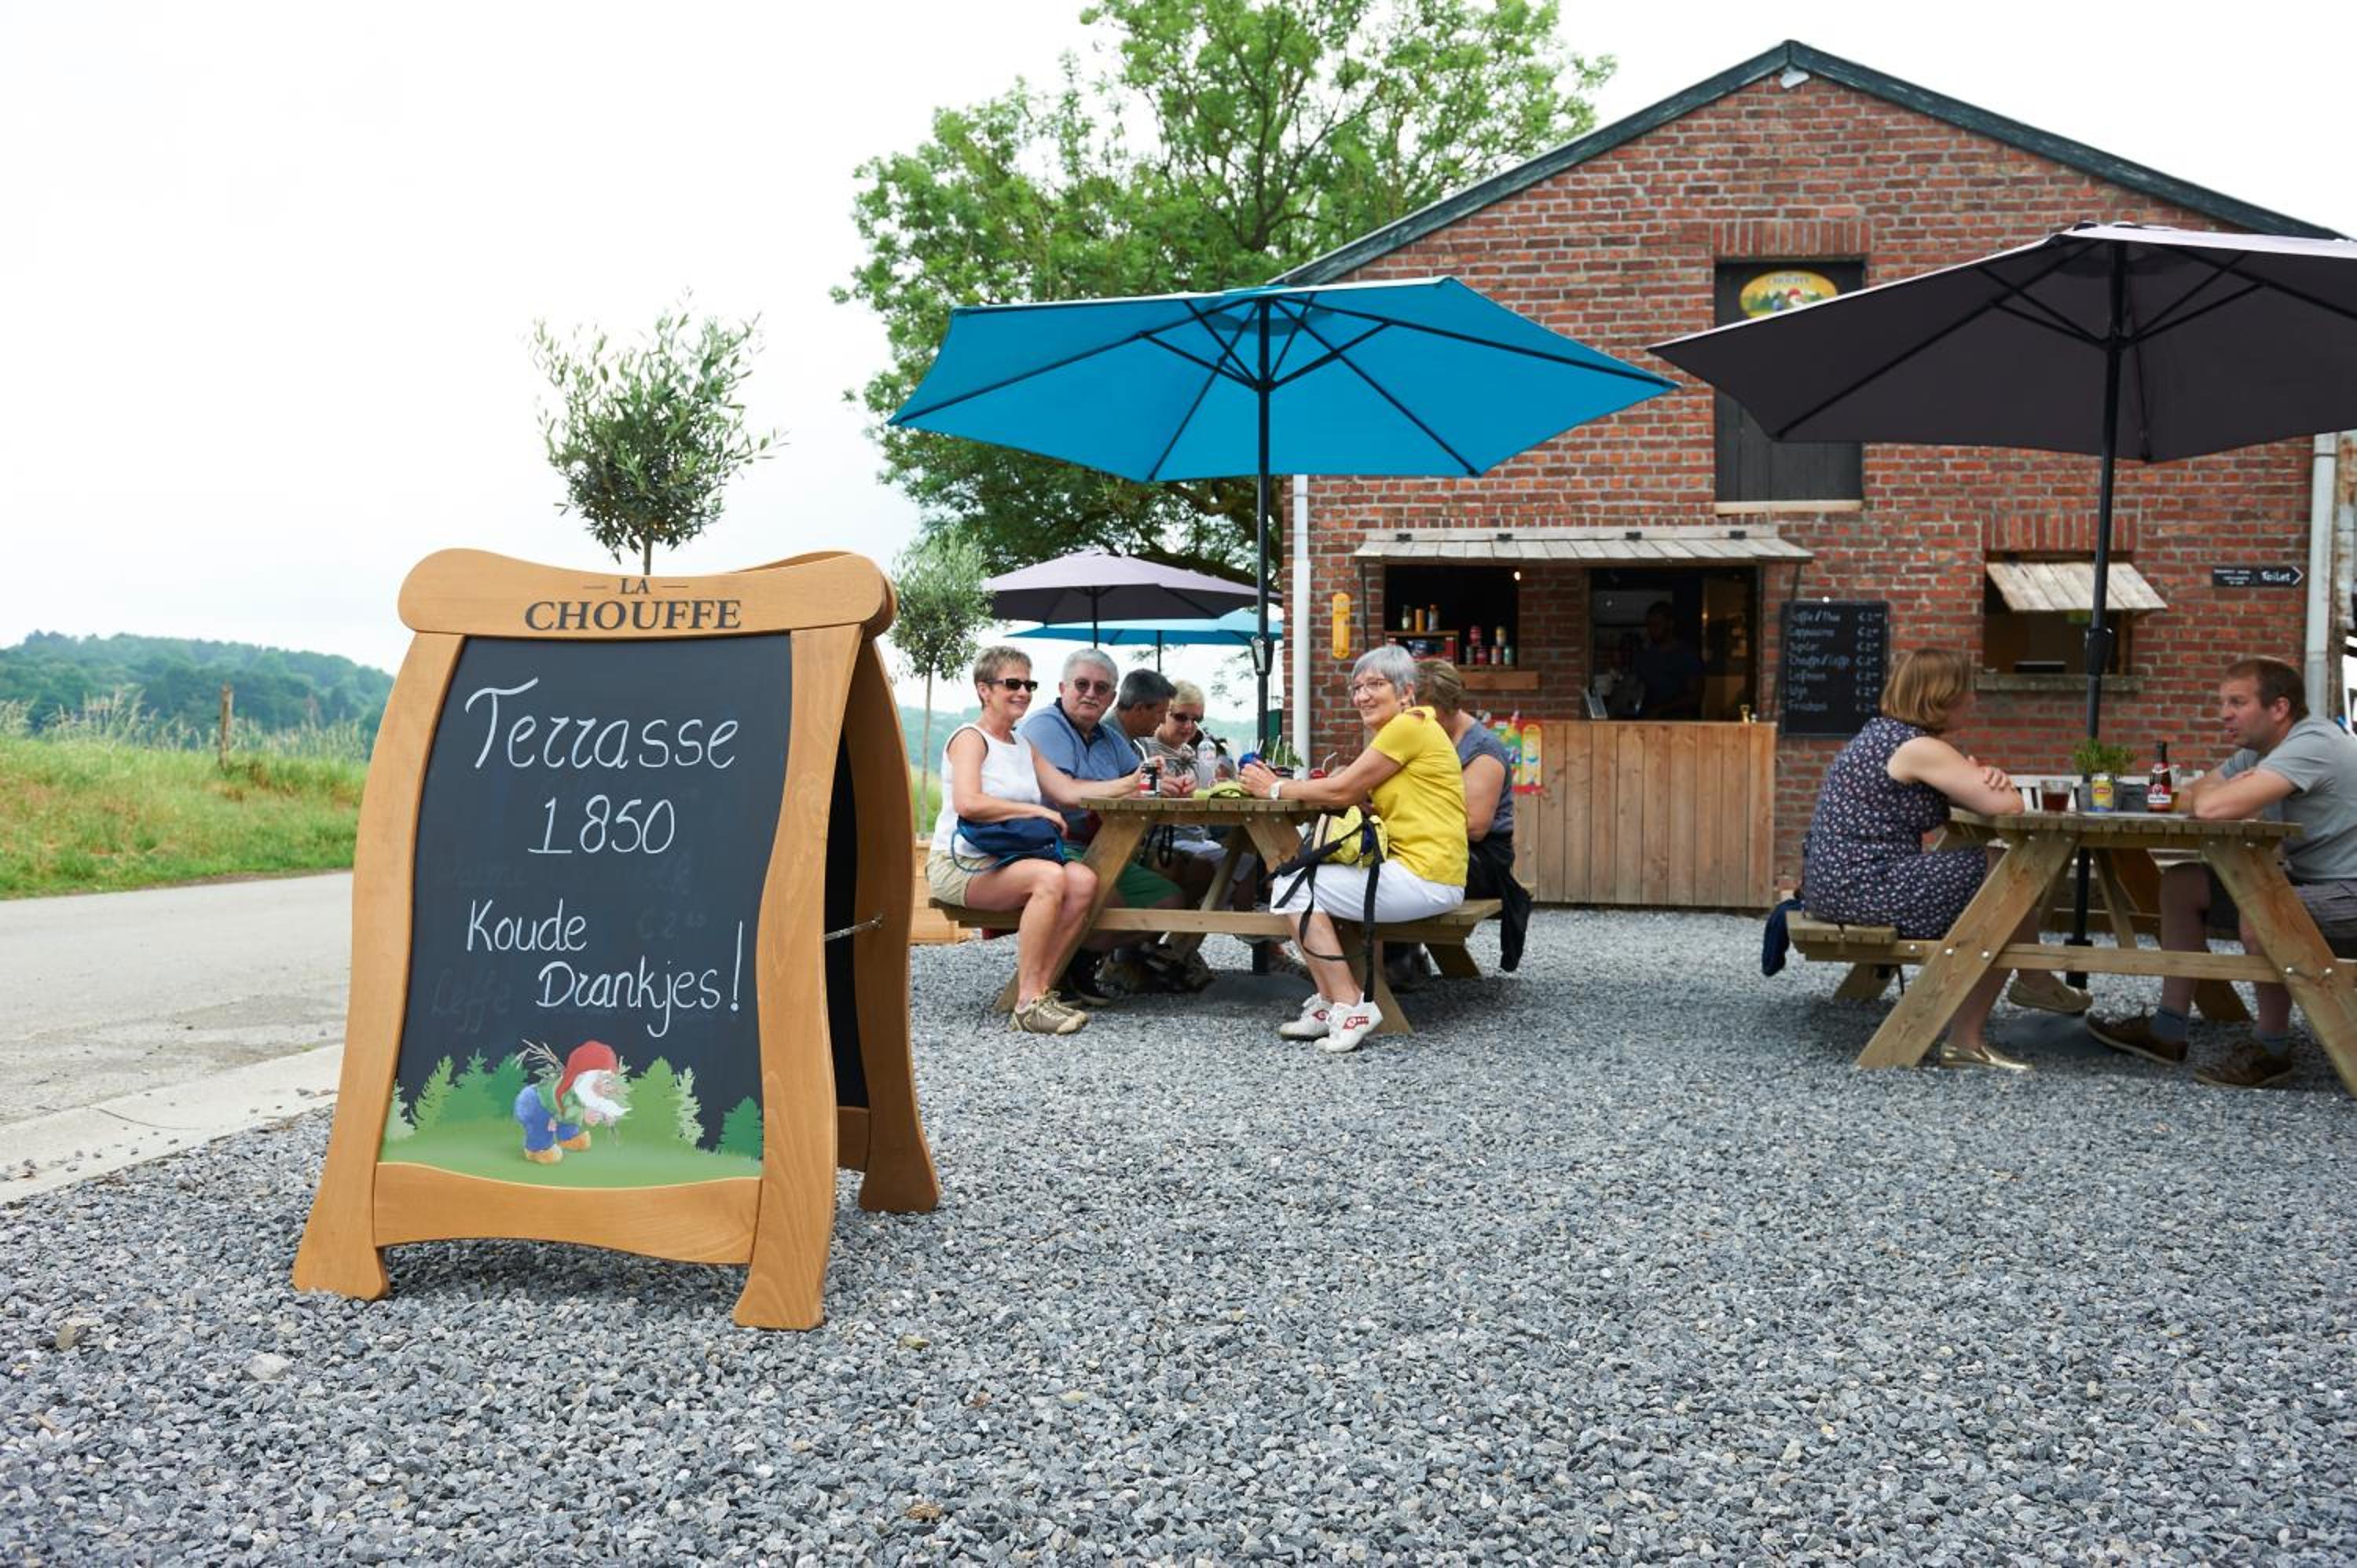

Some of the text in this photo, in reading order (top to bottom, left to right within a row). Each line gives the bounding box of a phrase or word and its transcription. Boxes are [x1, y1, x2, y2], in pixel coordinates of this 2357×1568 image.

[620, 577, 650, 595] LA
[525, 599, 741, 630] CHOUFFE
[465, 678, 738, 768] Terrasse
[528, 795, 674, 853] 1850
[467, 899, 587, 951] Koude
[536, 921, 742, 1037] Drankjes!
